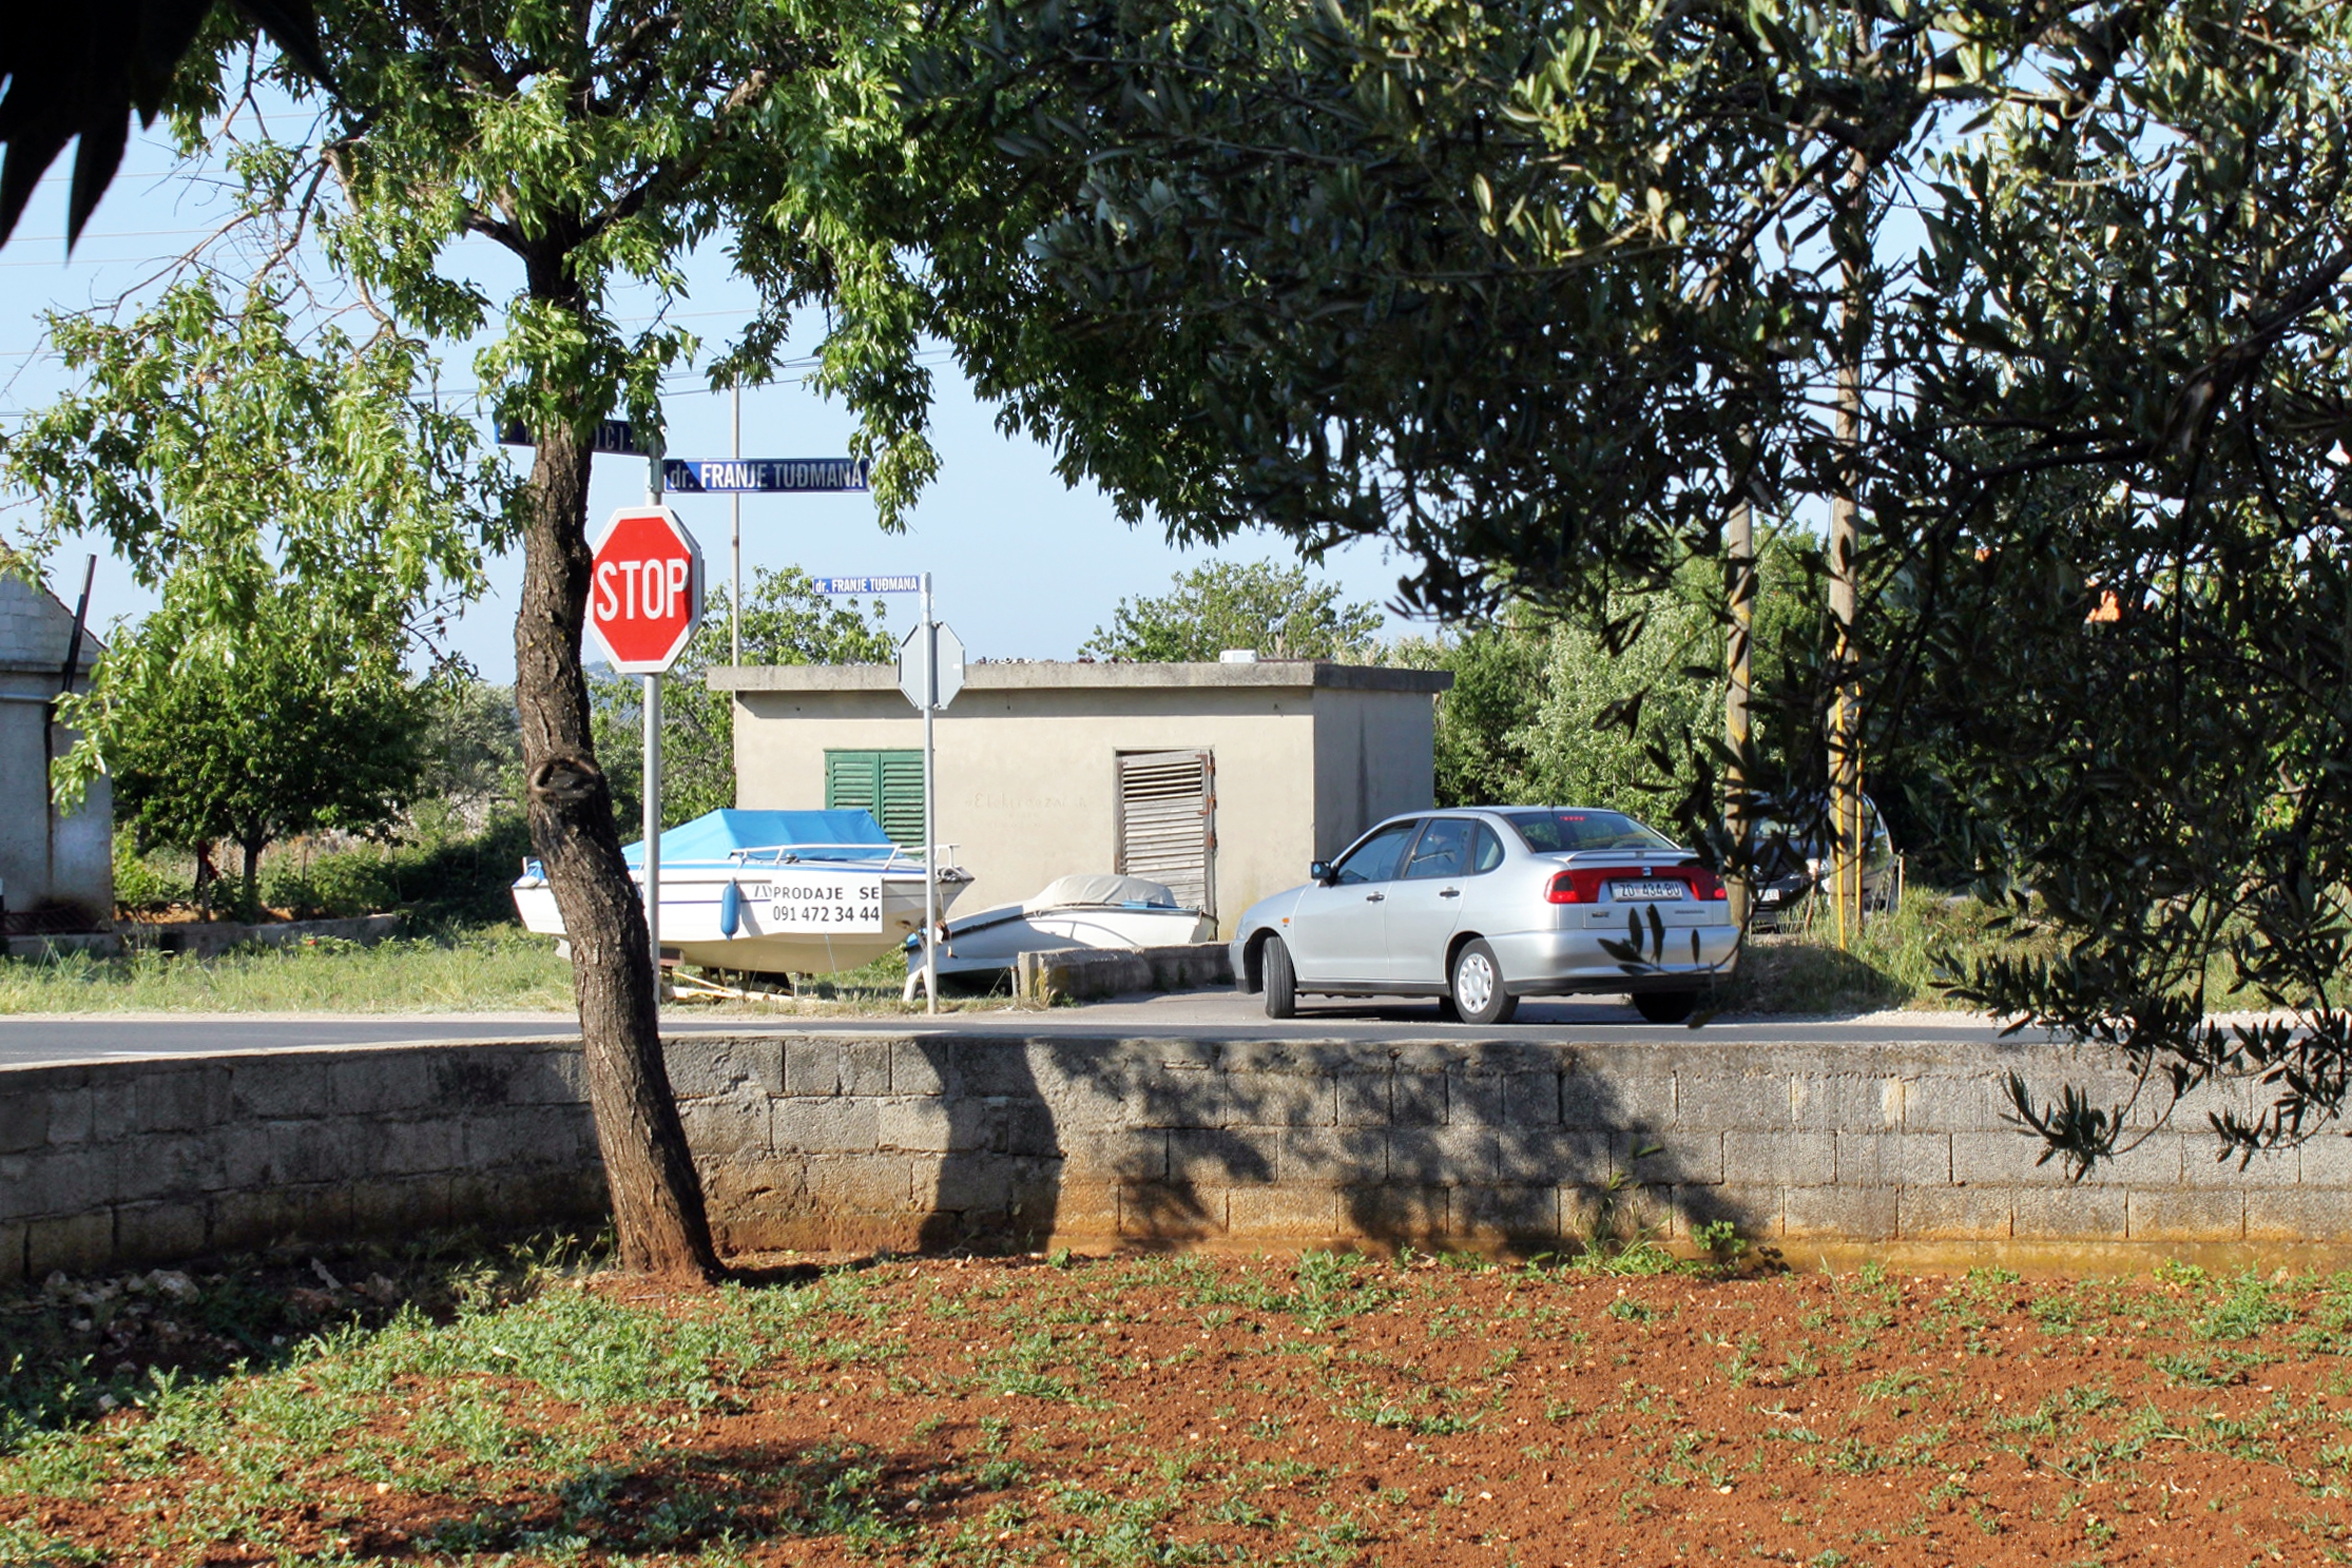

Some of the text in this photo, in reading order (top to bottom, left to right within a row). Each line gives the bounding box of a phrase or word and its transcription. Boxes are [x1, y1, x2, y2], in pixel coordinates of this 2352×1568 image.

[671, 463, 863, 488] dr. FRANJE TUĐMANA
[596, 558, 689, 621] STOP
[815, 577, 917, 593] dr. FRANJE TUĐMANA
[774, 886, 843, 900] PRODAJE
[859, 886, 880, 900] SE
[773, 906, 880, 922] 091 472 34 44
